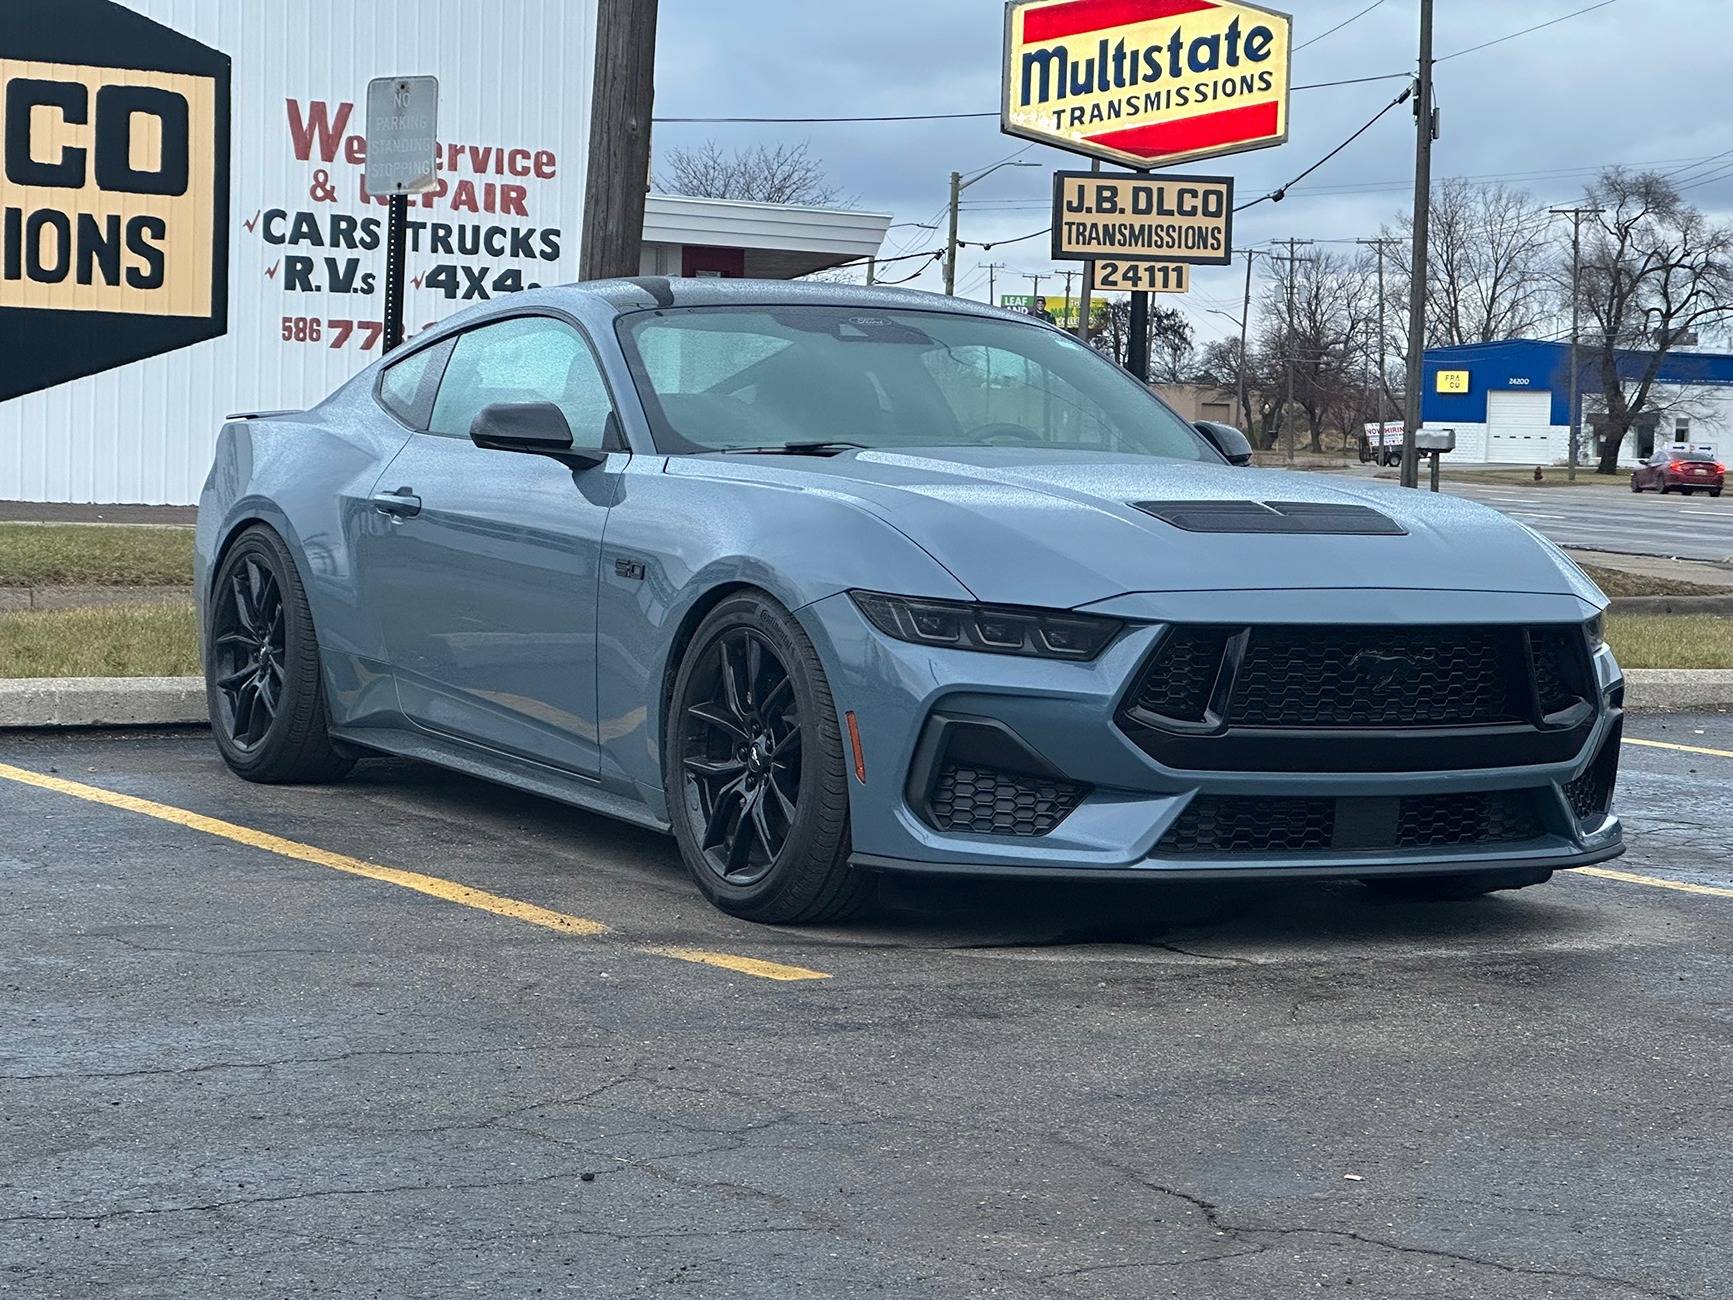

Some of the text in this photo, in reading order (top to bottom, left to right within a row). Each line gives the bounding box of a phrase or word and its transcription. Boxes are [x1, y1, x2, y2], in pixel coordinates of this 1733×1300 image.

[394, 92, 411, 108] NO
[1053, 70, 1273, 130] TRANSMISSIONS
[376, 114, 427, 131] PARKING
[286, 98, 556, 180] We rvice
[372, 138, 431, 155] STANDING
[371, 160, 431, 177] STOPPING
[309, 168, 529, 217] & PAIR
[1066, 184, 1224, 218] J.B. DLCO
[4, 206, 166, 290] IONS
[262, 208, 562, 262] CARS TRUCKS
[1064, 221, 1222, 251] TRANSMISSIONS
[284, 255, 376, 295] R.V.s
[1100, 262, 1184, 289] 24111
[1004, 296, 1028, 306] LEAF
[282, 316, 322, 342] 586
[1384, 426, 1404, 434] HIRIN
